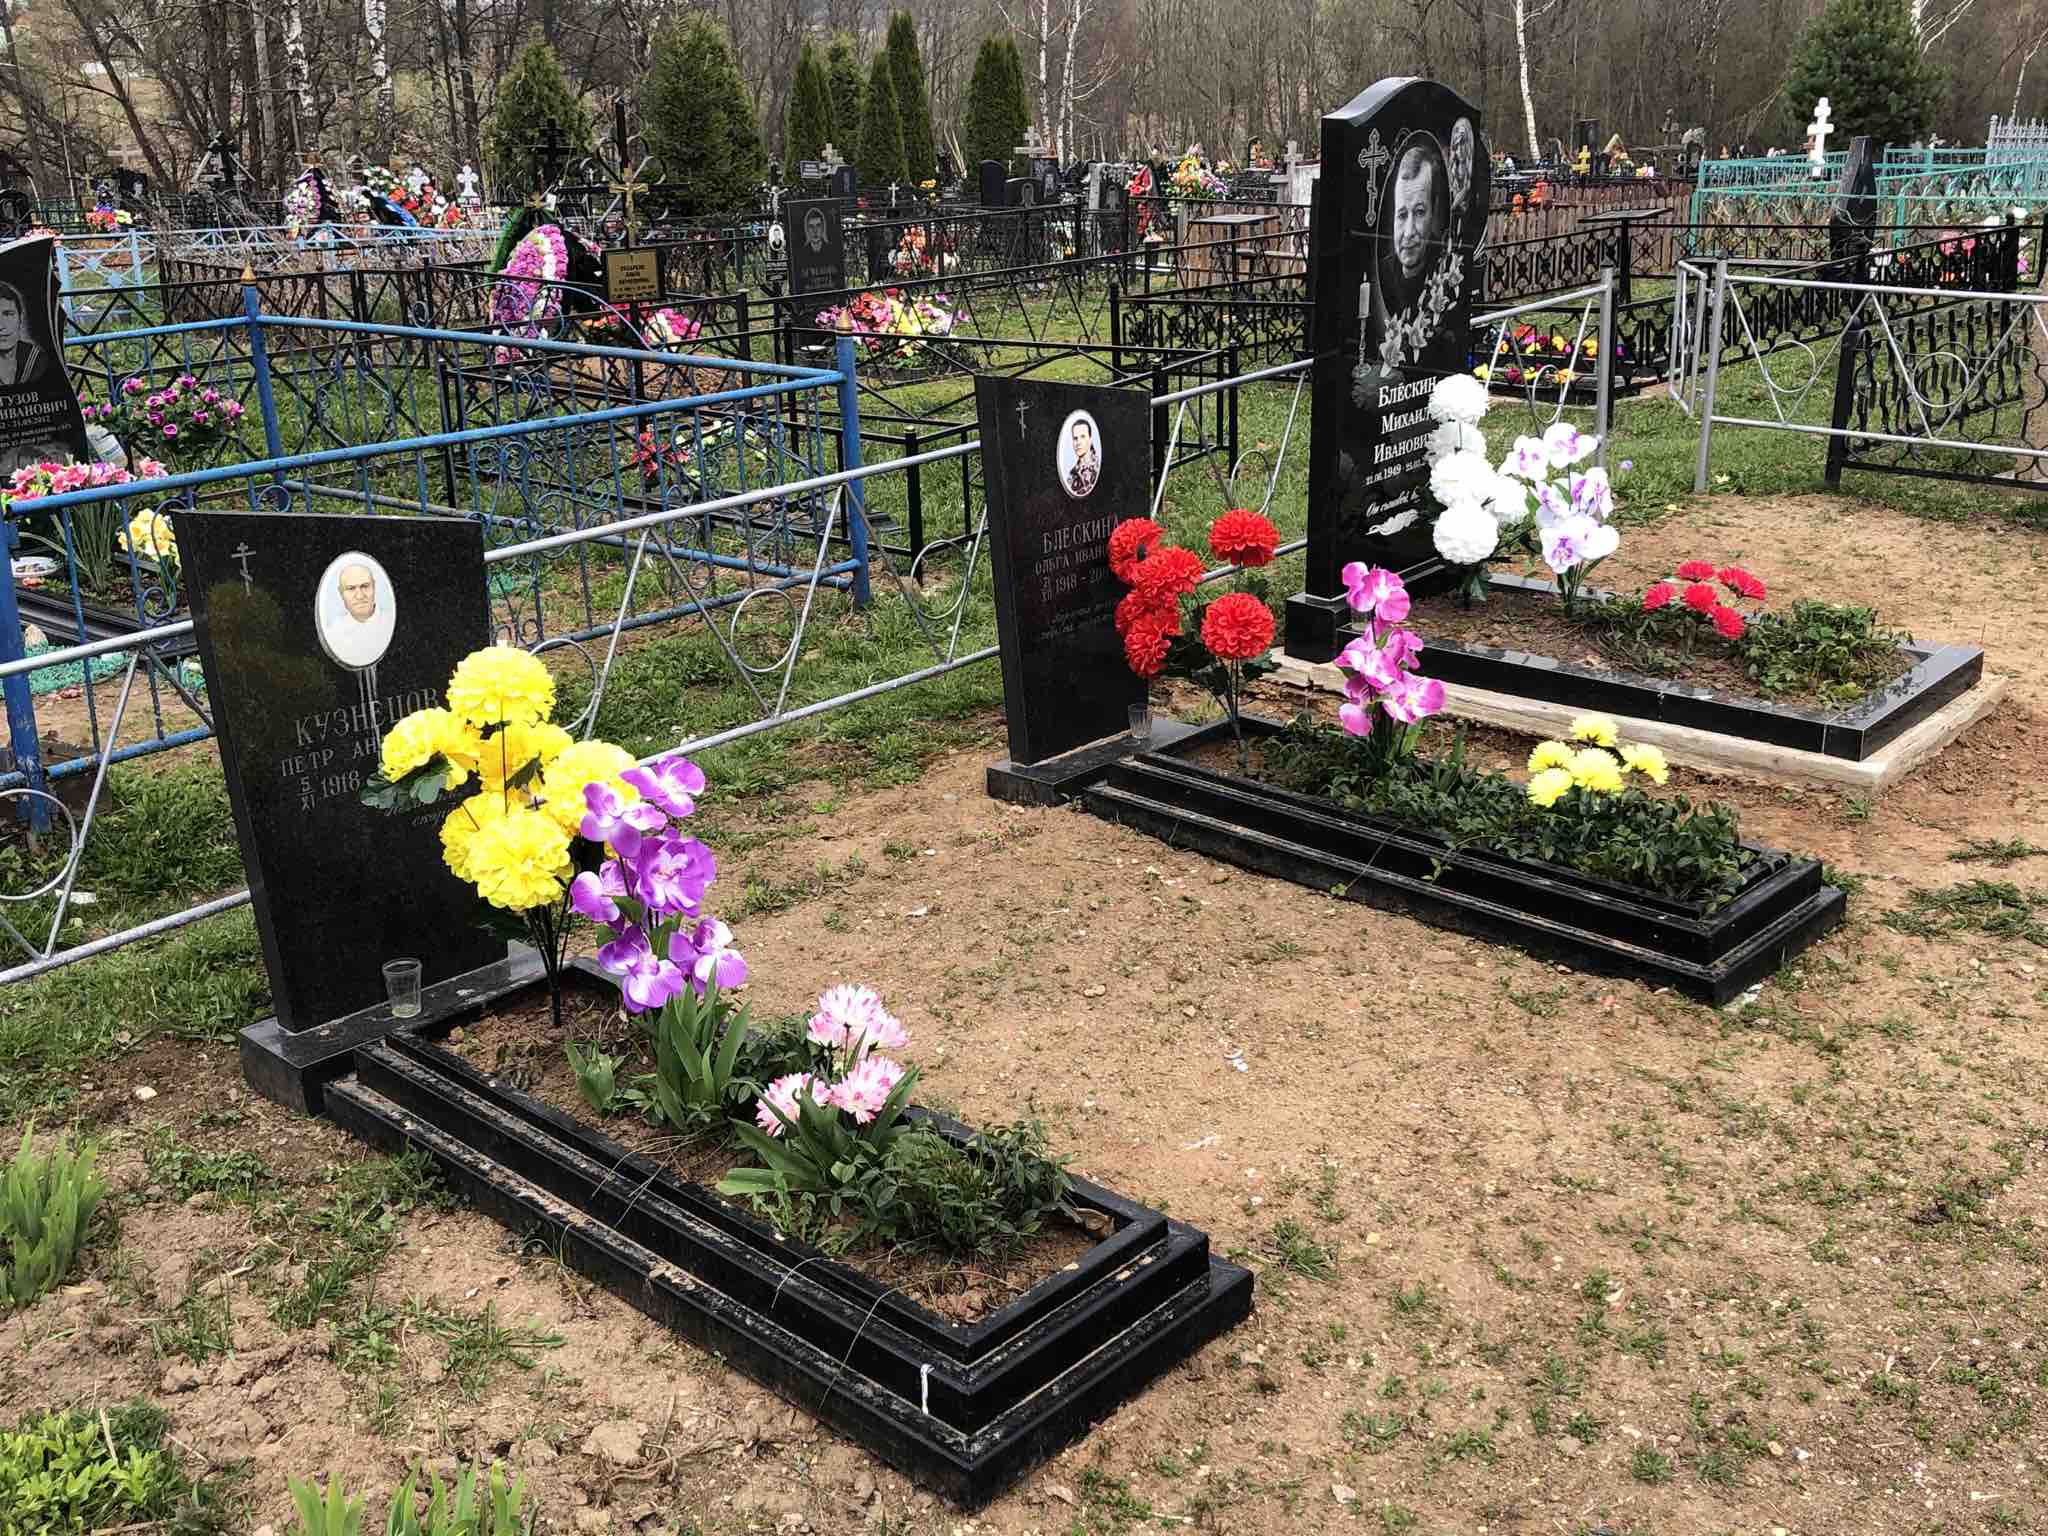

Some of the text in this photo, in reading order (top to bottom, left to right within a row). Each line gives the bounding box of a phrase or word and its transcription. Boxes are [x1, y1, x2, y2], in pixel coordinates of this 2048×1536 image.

[1034, 553, 1070, 576] ОЛЬГА
[280, 748, 335, 777] ПЕТР
[321, 769, 361, 799] 1918
